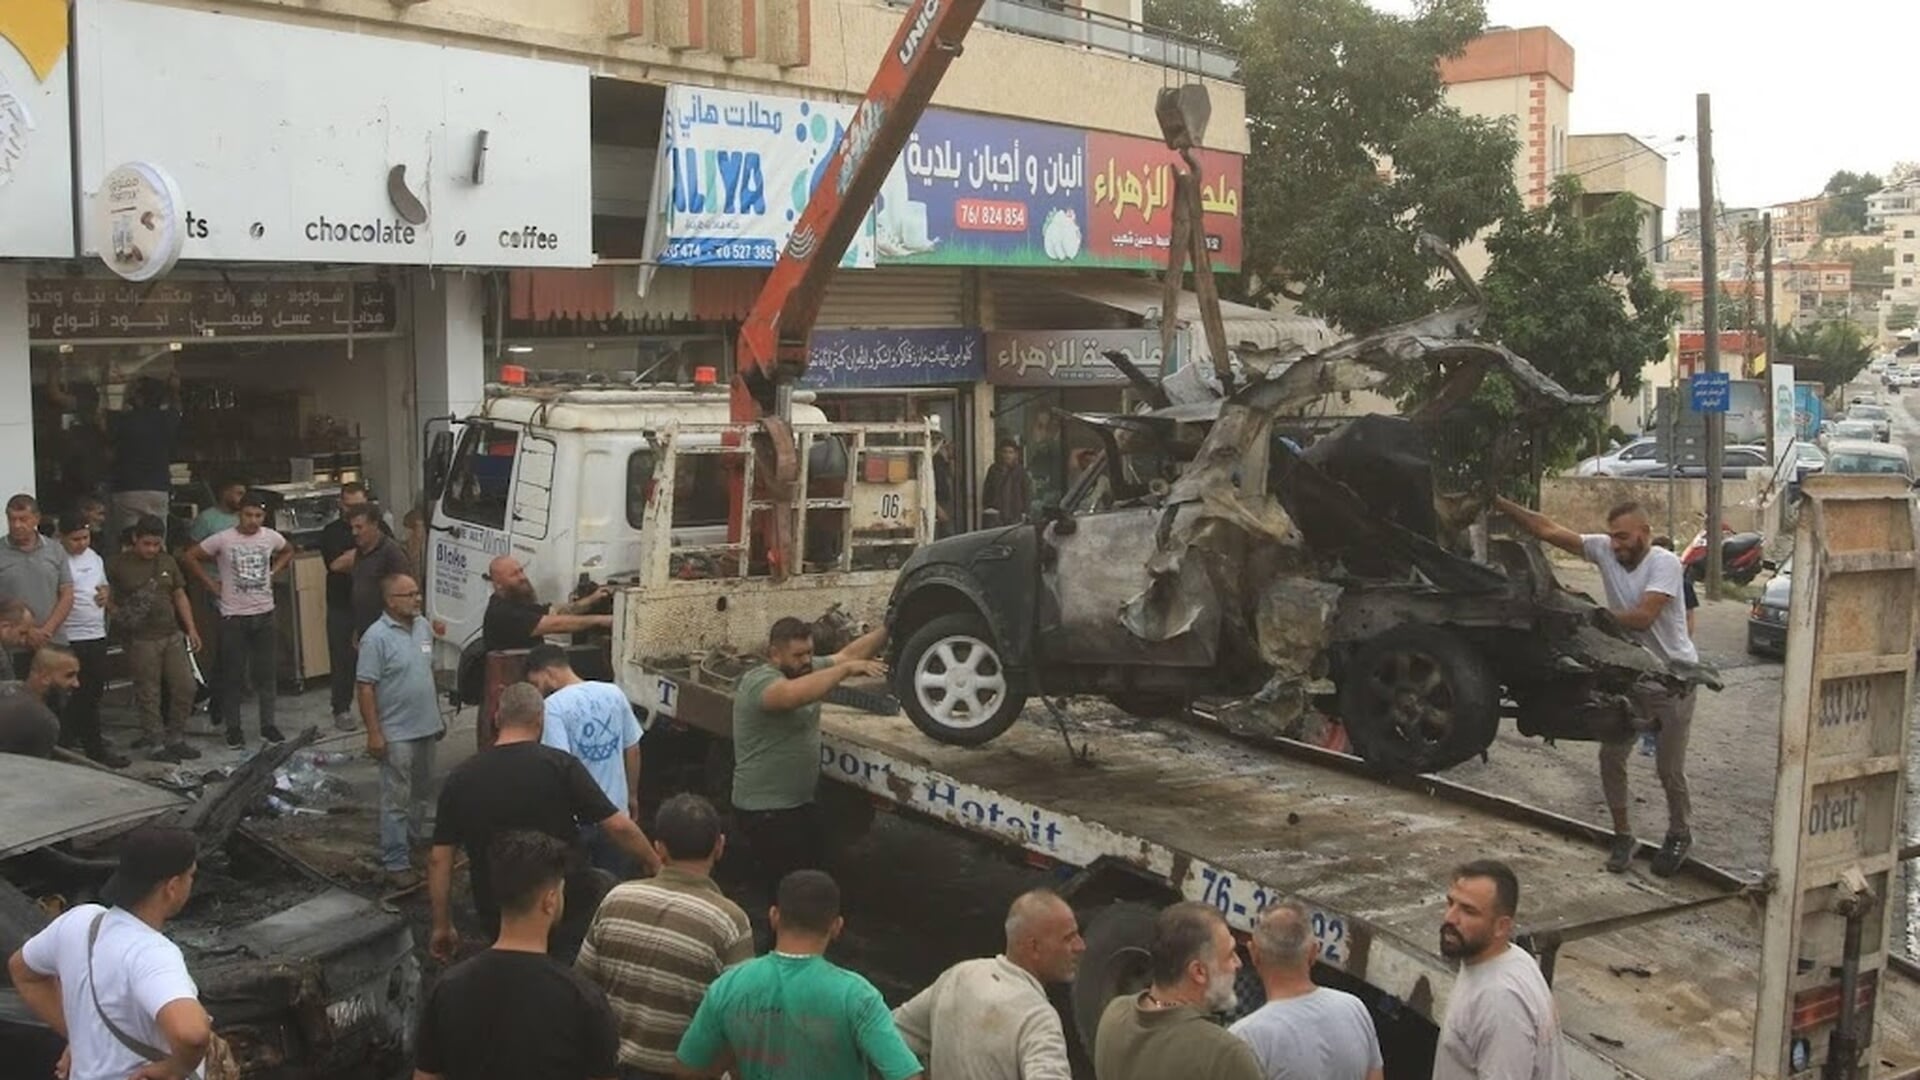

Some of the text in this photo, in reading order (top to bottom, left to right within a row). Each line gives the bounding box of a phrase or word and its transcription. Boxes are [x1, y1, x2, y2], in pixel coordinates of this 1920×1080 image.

[679, 94, 782, 138] محلات هاني
[907, 132, 962, 187] بلدية
[969, 139, 1020, 192] أجبان
[1025, 155, 1038, 195] و
[1044, 147, 1083, 196] ألبان
[1094, 157, 1238, 223] ملح الزهراء
[305, 215, 416, 245] chocolate
[499, 226, 558, 250] coffee
[982, 207, 1003, 226] 824
[1004, 208, 1025, 227] 854
[733, 245, 751, 260] 527
[272, 311, 312, 328] عسل
[998, 339, 1076, 377] الزهراء
[882, 494, 900, 519] 06
